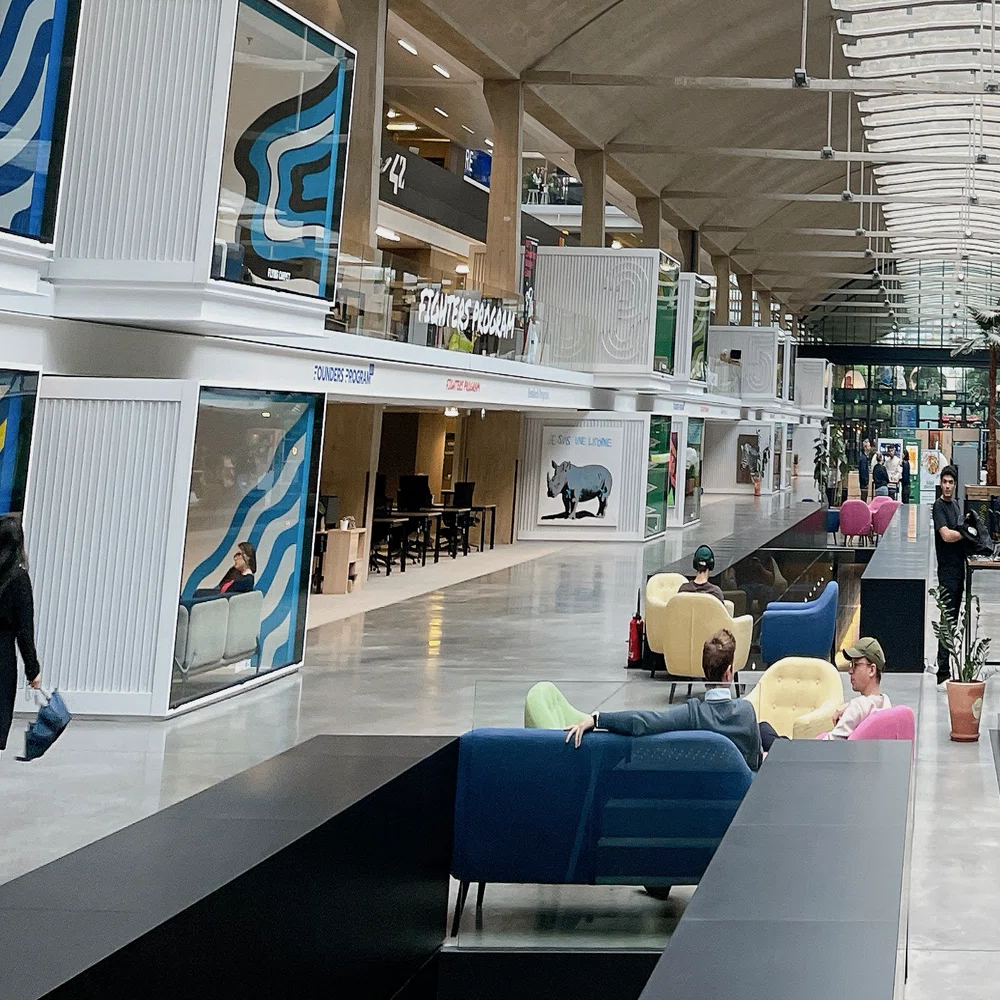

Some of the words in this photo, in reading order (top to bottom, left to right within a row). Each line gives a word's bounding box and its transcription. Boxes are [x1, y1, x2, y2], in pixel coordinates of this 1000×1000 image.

[472, 300, 515, 339] PROGRAM
[313, 365, 344, 382] FOUNDERS
[344, 368, 371, 384] PROGRAM
